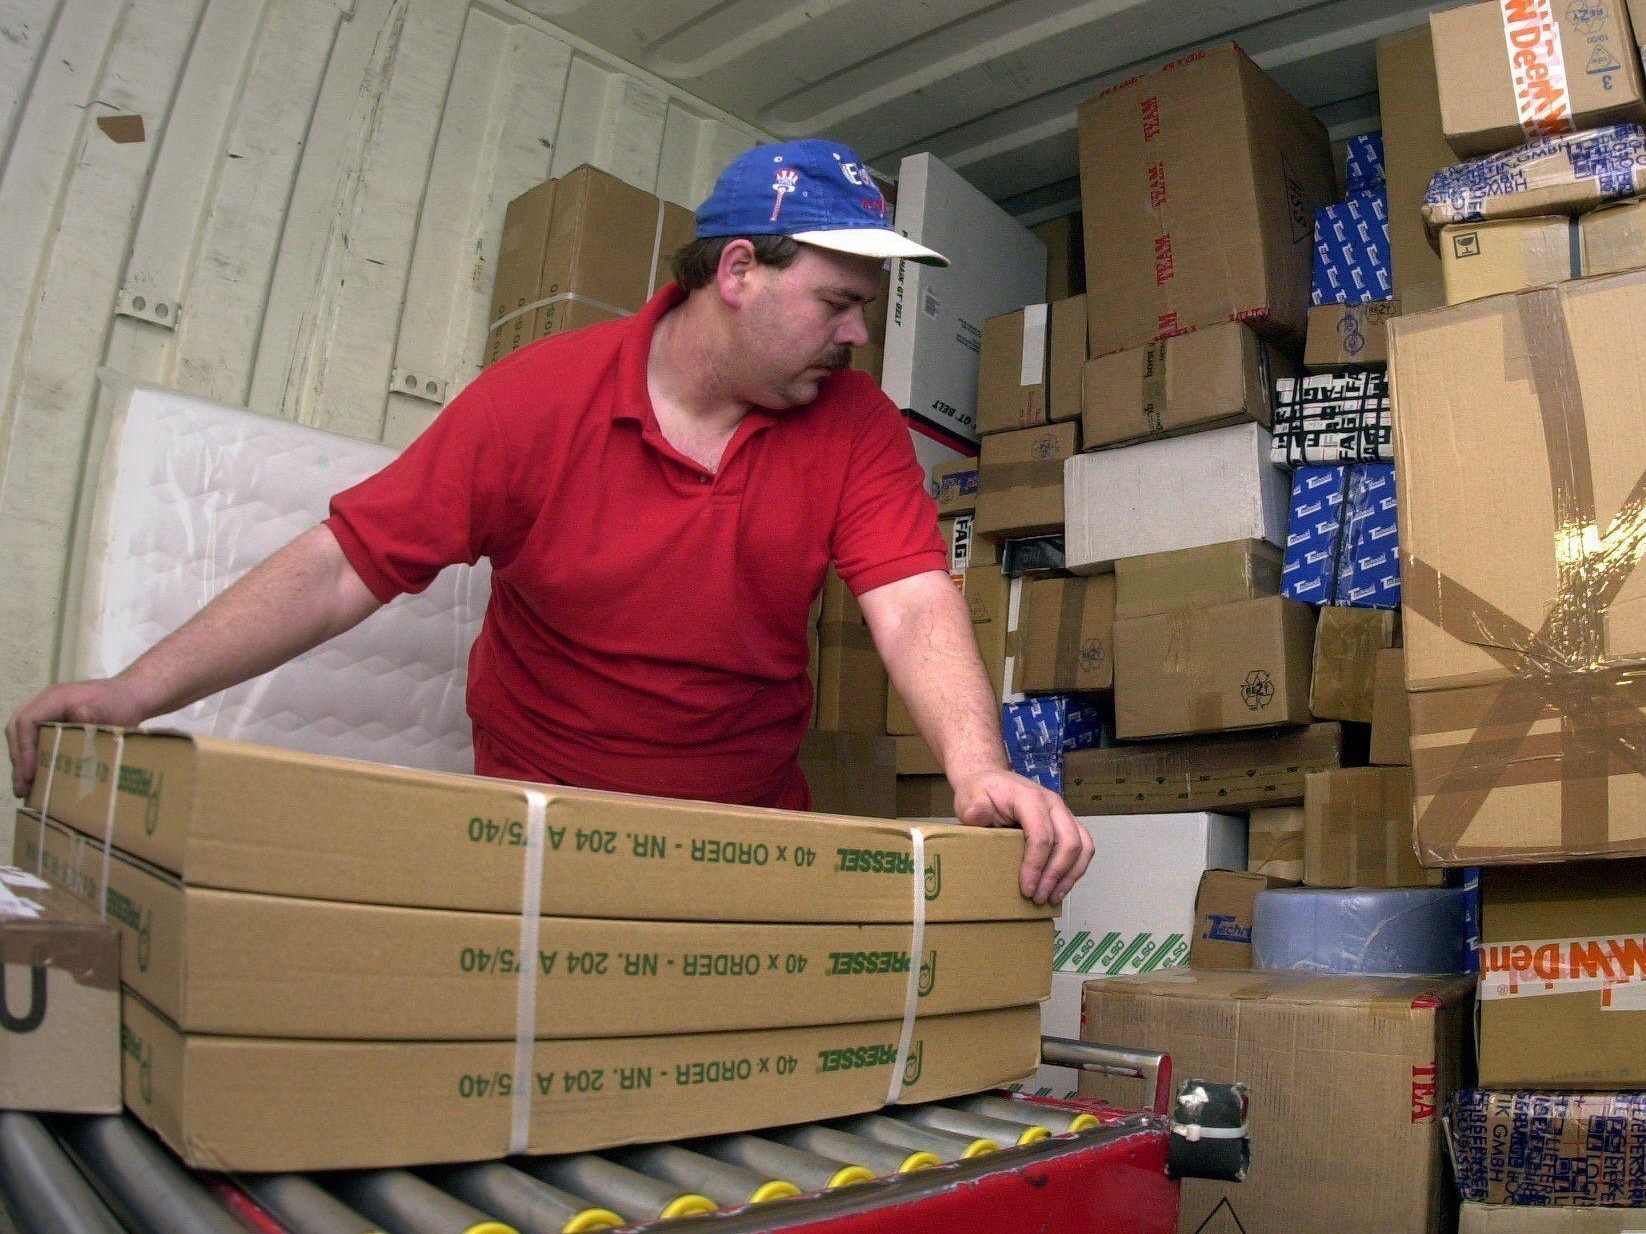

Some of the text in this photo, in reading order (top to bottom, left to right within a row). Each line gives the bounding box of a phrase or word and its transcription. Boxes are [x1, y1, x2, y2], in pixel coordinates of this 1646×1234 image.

[954, 519, 967, 559] FAG
[547, 826, 567, 851] A
[575, 827, 618, 854] 204
[626, 832, 667, 859] NR.
[691, 838, 769, 867] ORDER
[776, 845, 788, 862] x
[794, 847, 816, 868] 40
[538, 950, 558, 976] A
[566, 951, 609, 977] 204
[619, 952, 659, 977] NR.
[768, 954, 779, 970] x
[785, 953, 808, 974] 40
[1071, 937, 1095, 967] ELSO
[1101, 938, 1126, 968] ELSO
[1131, 939, 1157, 969] ELSO
[683, 953, 761, 977] ORDER
[676, 1058, 751, 1086] ORDER
[759, 1056, 769, 1073] x
[776, 1054, 798, 1076] 40
[536, 1071, 555, 1096] A
[563, 1069, 605, 1094] 204
[614, 1066, 652, 1091] NR.
